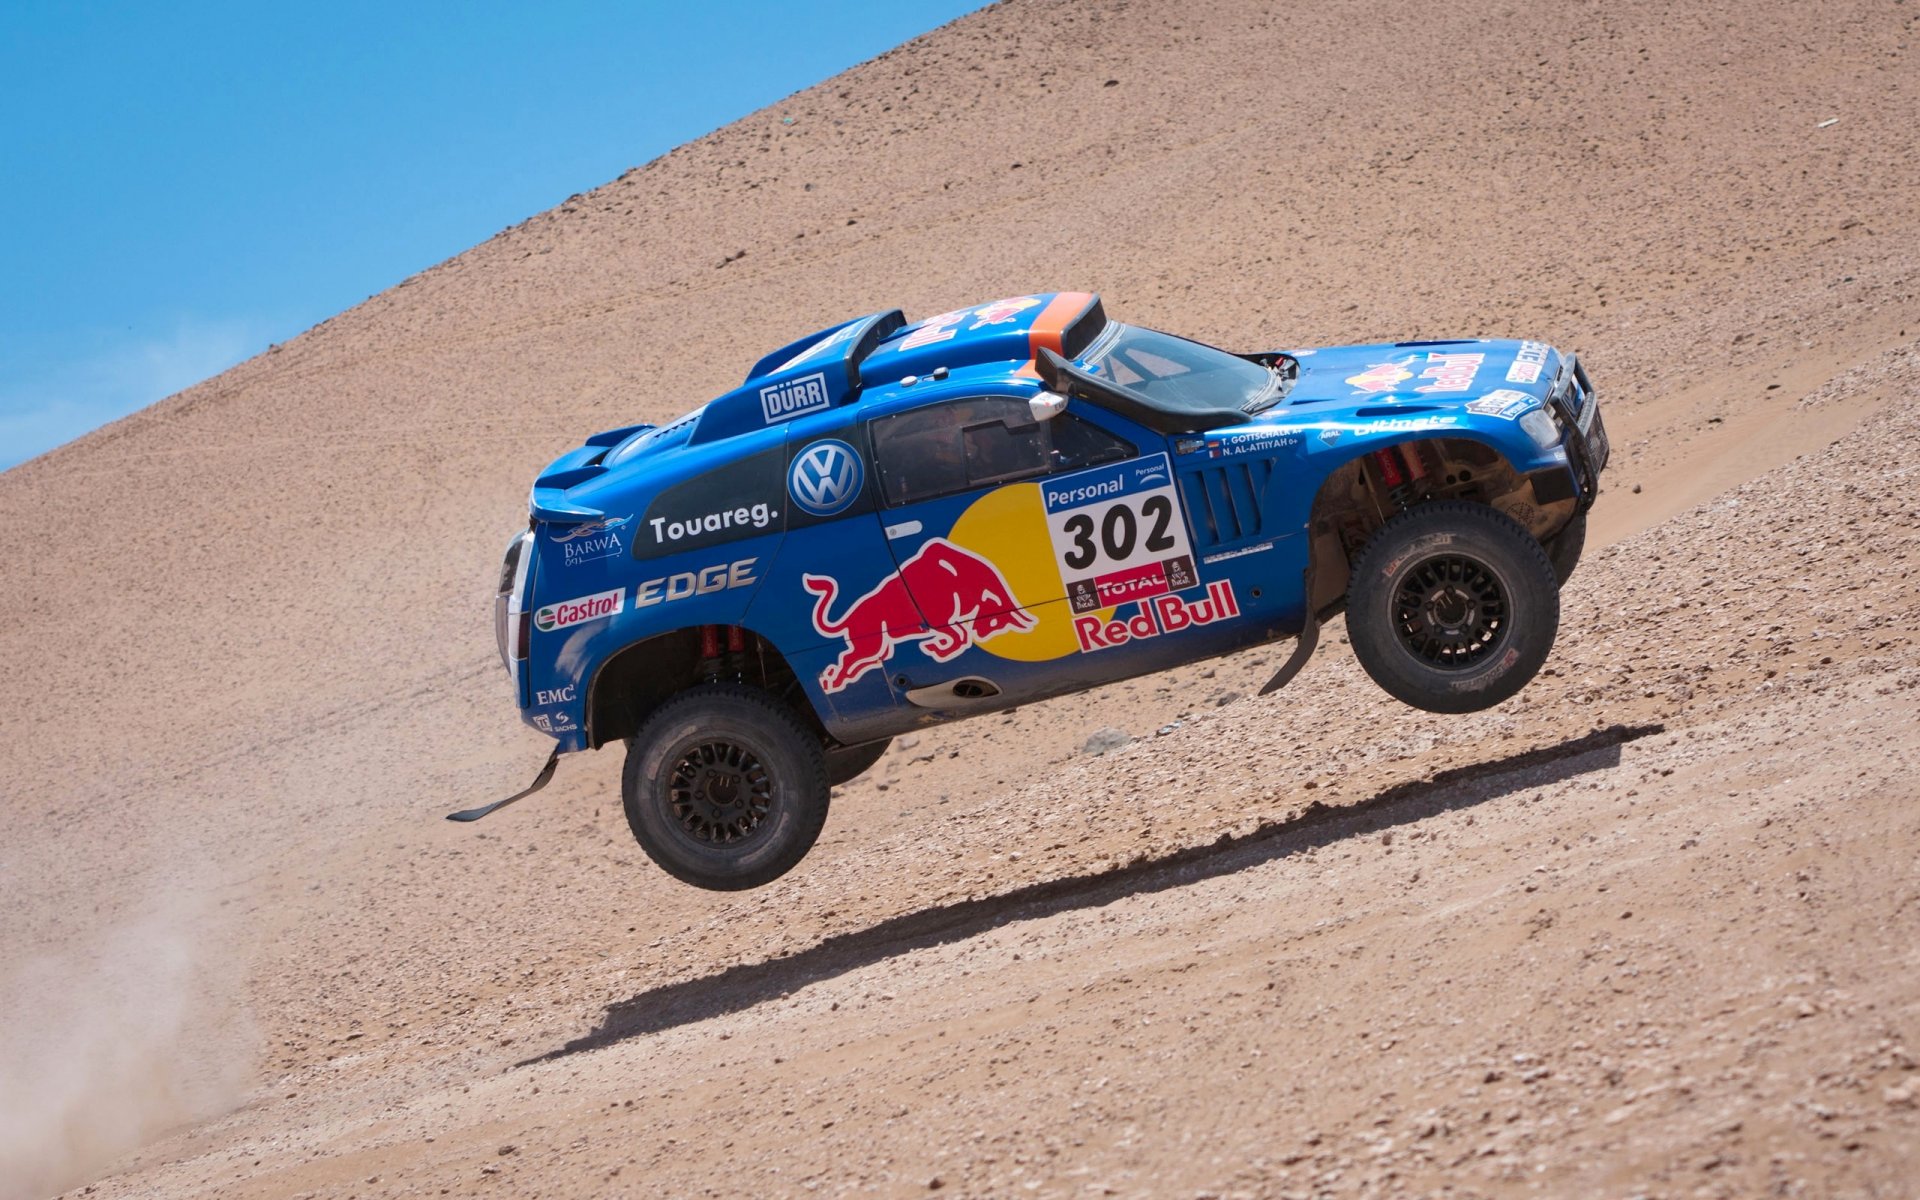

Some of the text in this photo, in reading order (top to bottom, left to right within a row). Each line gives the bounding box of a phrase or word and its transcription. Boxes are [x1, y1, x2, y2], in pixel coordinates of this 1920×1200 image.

[767, 381, 823, 415] DÜRR
[1222, 447, 1233, 457] N.
[1235, 438, 1288, 455] AL-ATTIYAH
[1231, 429, 1291, 444] GOTTSCHALK
[1135, 462, 1165, 476] Personal
[1048, 474, 1124, 508] Personal
[650, 503, 778, 543] Touareg.
[1063, 495, 1175, 570] 302
[634, 557, 760, 609] EDGE
[1098, 574, 1167, 598] TOTAL
[557, 592, 619, 625] Castrol
[1073, 581, 1238, 651] Red Bull
[554, 723, 578, 732] SACHS
